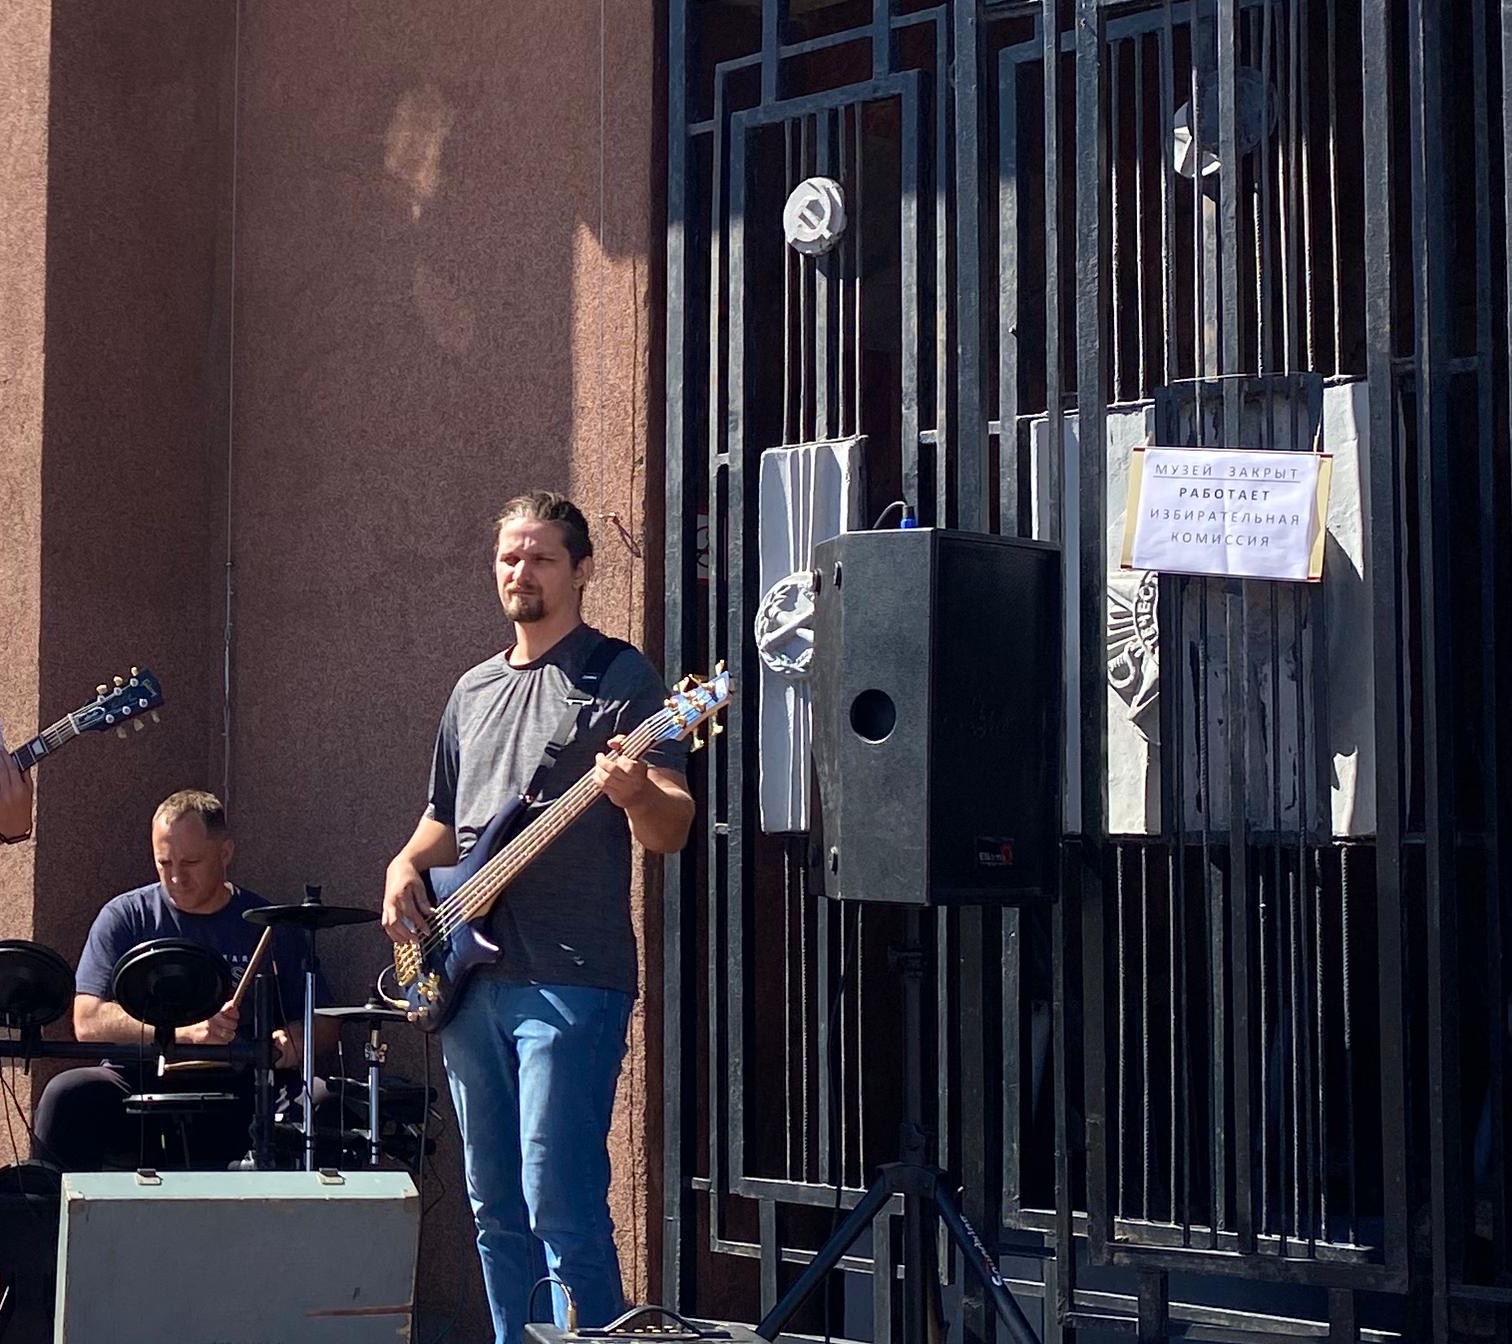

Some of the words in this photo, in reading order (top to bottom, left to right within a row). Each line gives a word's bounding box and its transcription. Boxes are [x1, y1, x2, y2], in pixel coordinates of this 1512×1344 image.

[1154, 462, 1213, 477] МУЗЕЙ
[1228, 466, 1299, 481] ЗАКРЫТ
[1179, 487, 1271, 502] РАБОТАЕТ
[1149, 508, 1301, 527] ИЗБИРАТЕЛЬНАЯ
[1171, 532, 1270, 548] КОМИССИЯ
